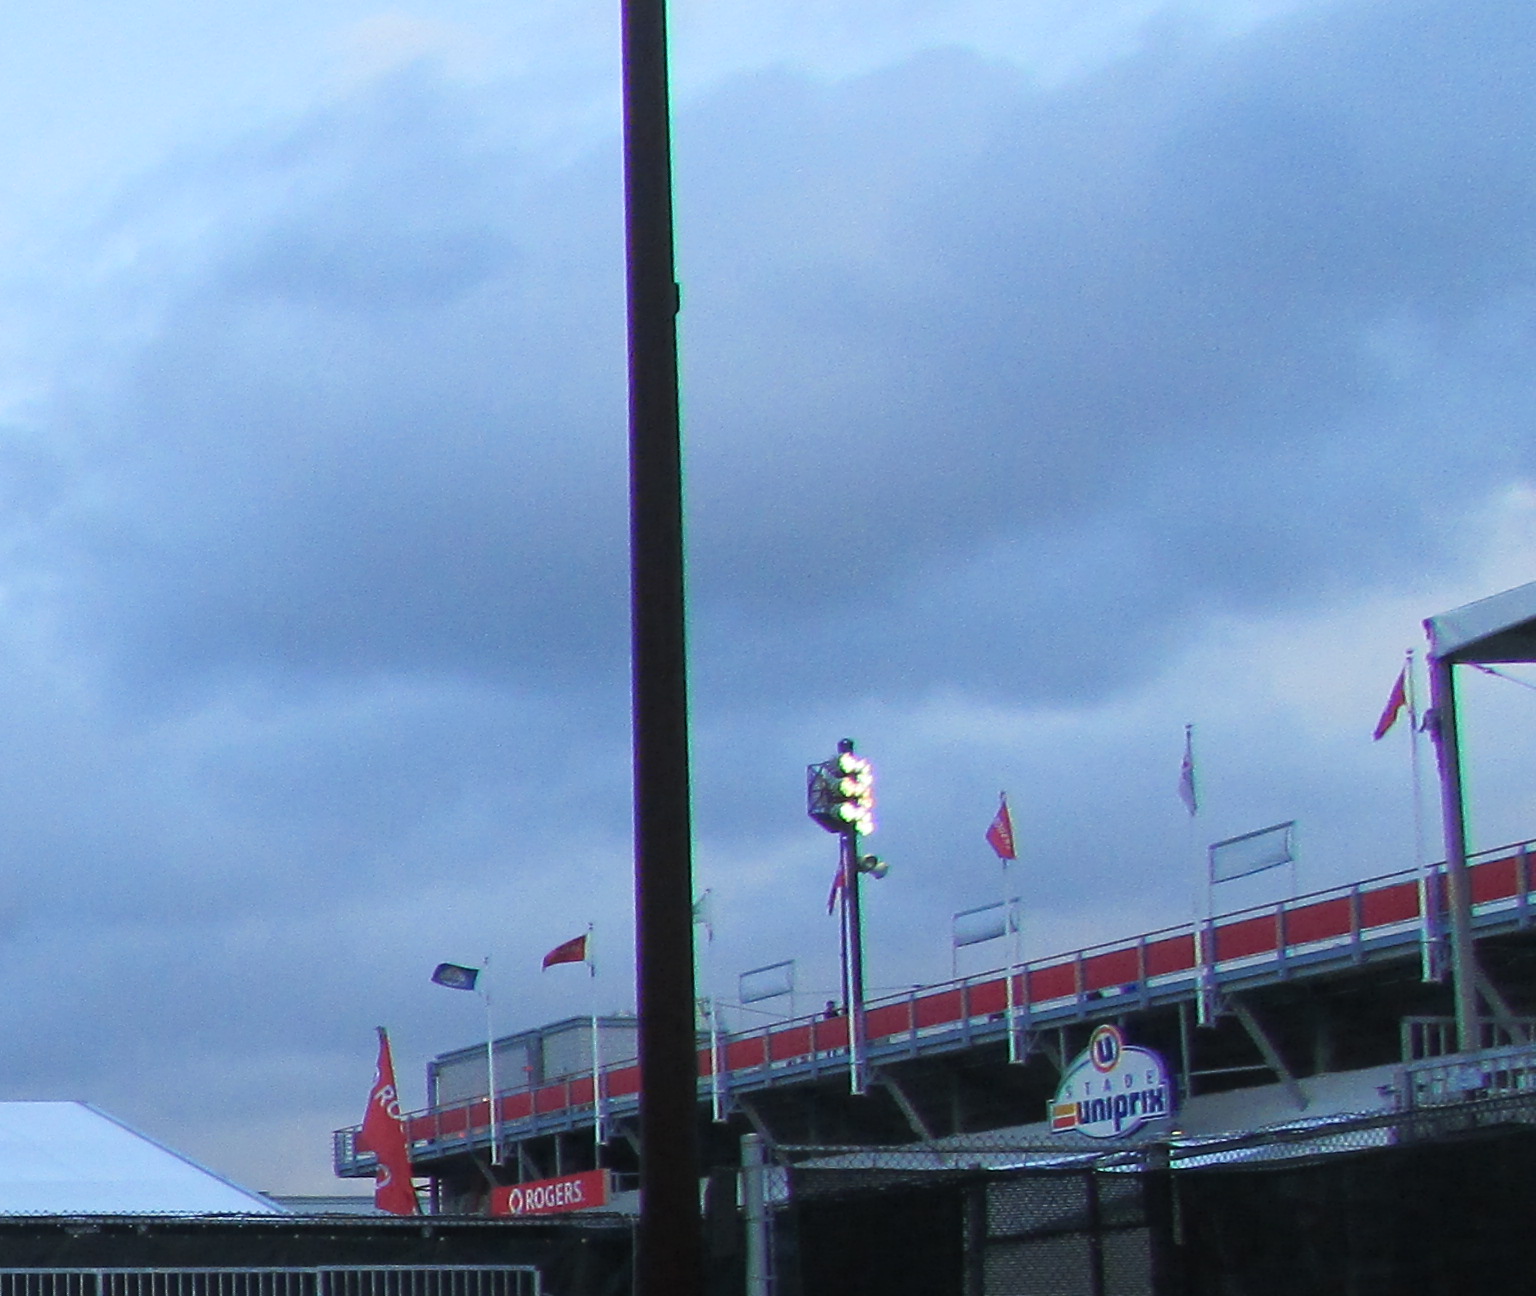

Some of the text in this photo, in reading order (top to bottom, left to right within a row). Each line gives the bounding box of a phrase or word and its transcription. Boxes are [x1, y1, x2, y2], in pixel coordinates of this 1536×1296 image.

[1065, 1069, 1154, 1099] STADE
[1077, 1088, 1165, 1132] uniprix
[526, 1179, 583, 1211] ROGERS
